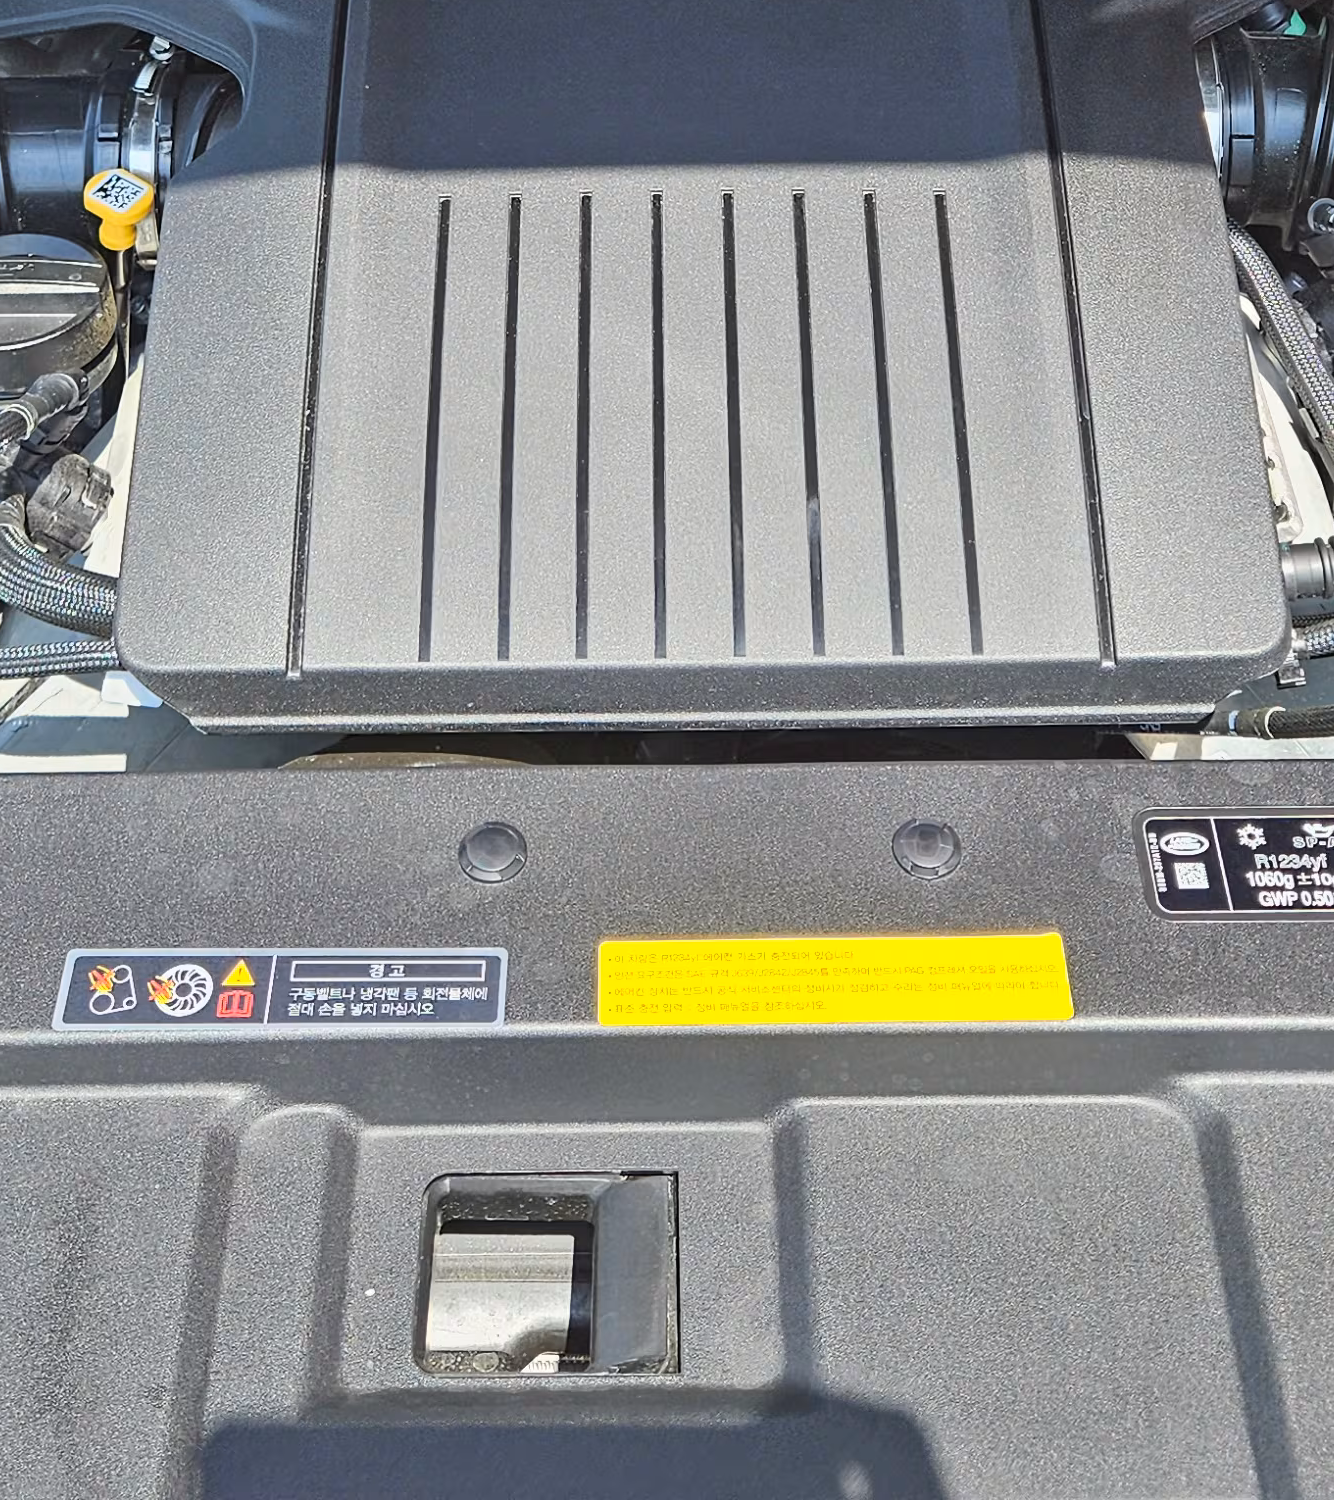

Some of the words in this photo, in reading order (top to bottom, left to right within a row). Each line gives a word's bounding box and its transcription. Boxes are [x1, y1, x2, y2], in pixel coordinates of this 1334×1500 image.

[1254, 853, 1327, 872] R1234yf
[1245, 871, 1295, 889] 1060g
[1258, 890, 1298, 907] GWP
[369, 964, 406, 978] 경고
[288, 987, 356, 1001] 구동벨트나
[360, 986, 400, 1001] 냉각팬
[403, 987, 418, 1000] 등
[287, 1003, 315, 1017] 절대
[317, 1003, 346, 1017] 손을
[350, 1002, 377, 1016] 넣지
